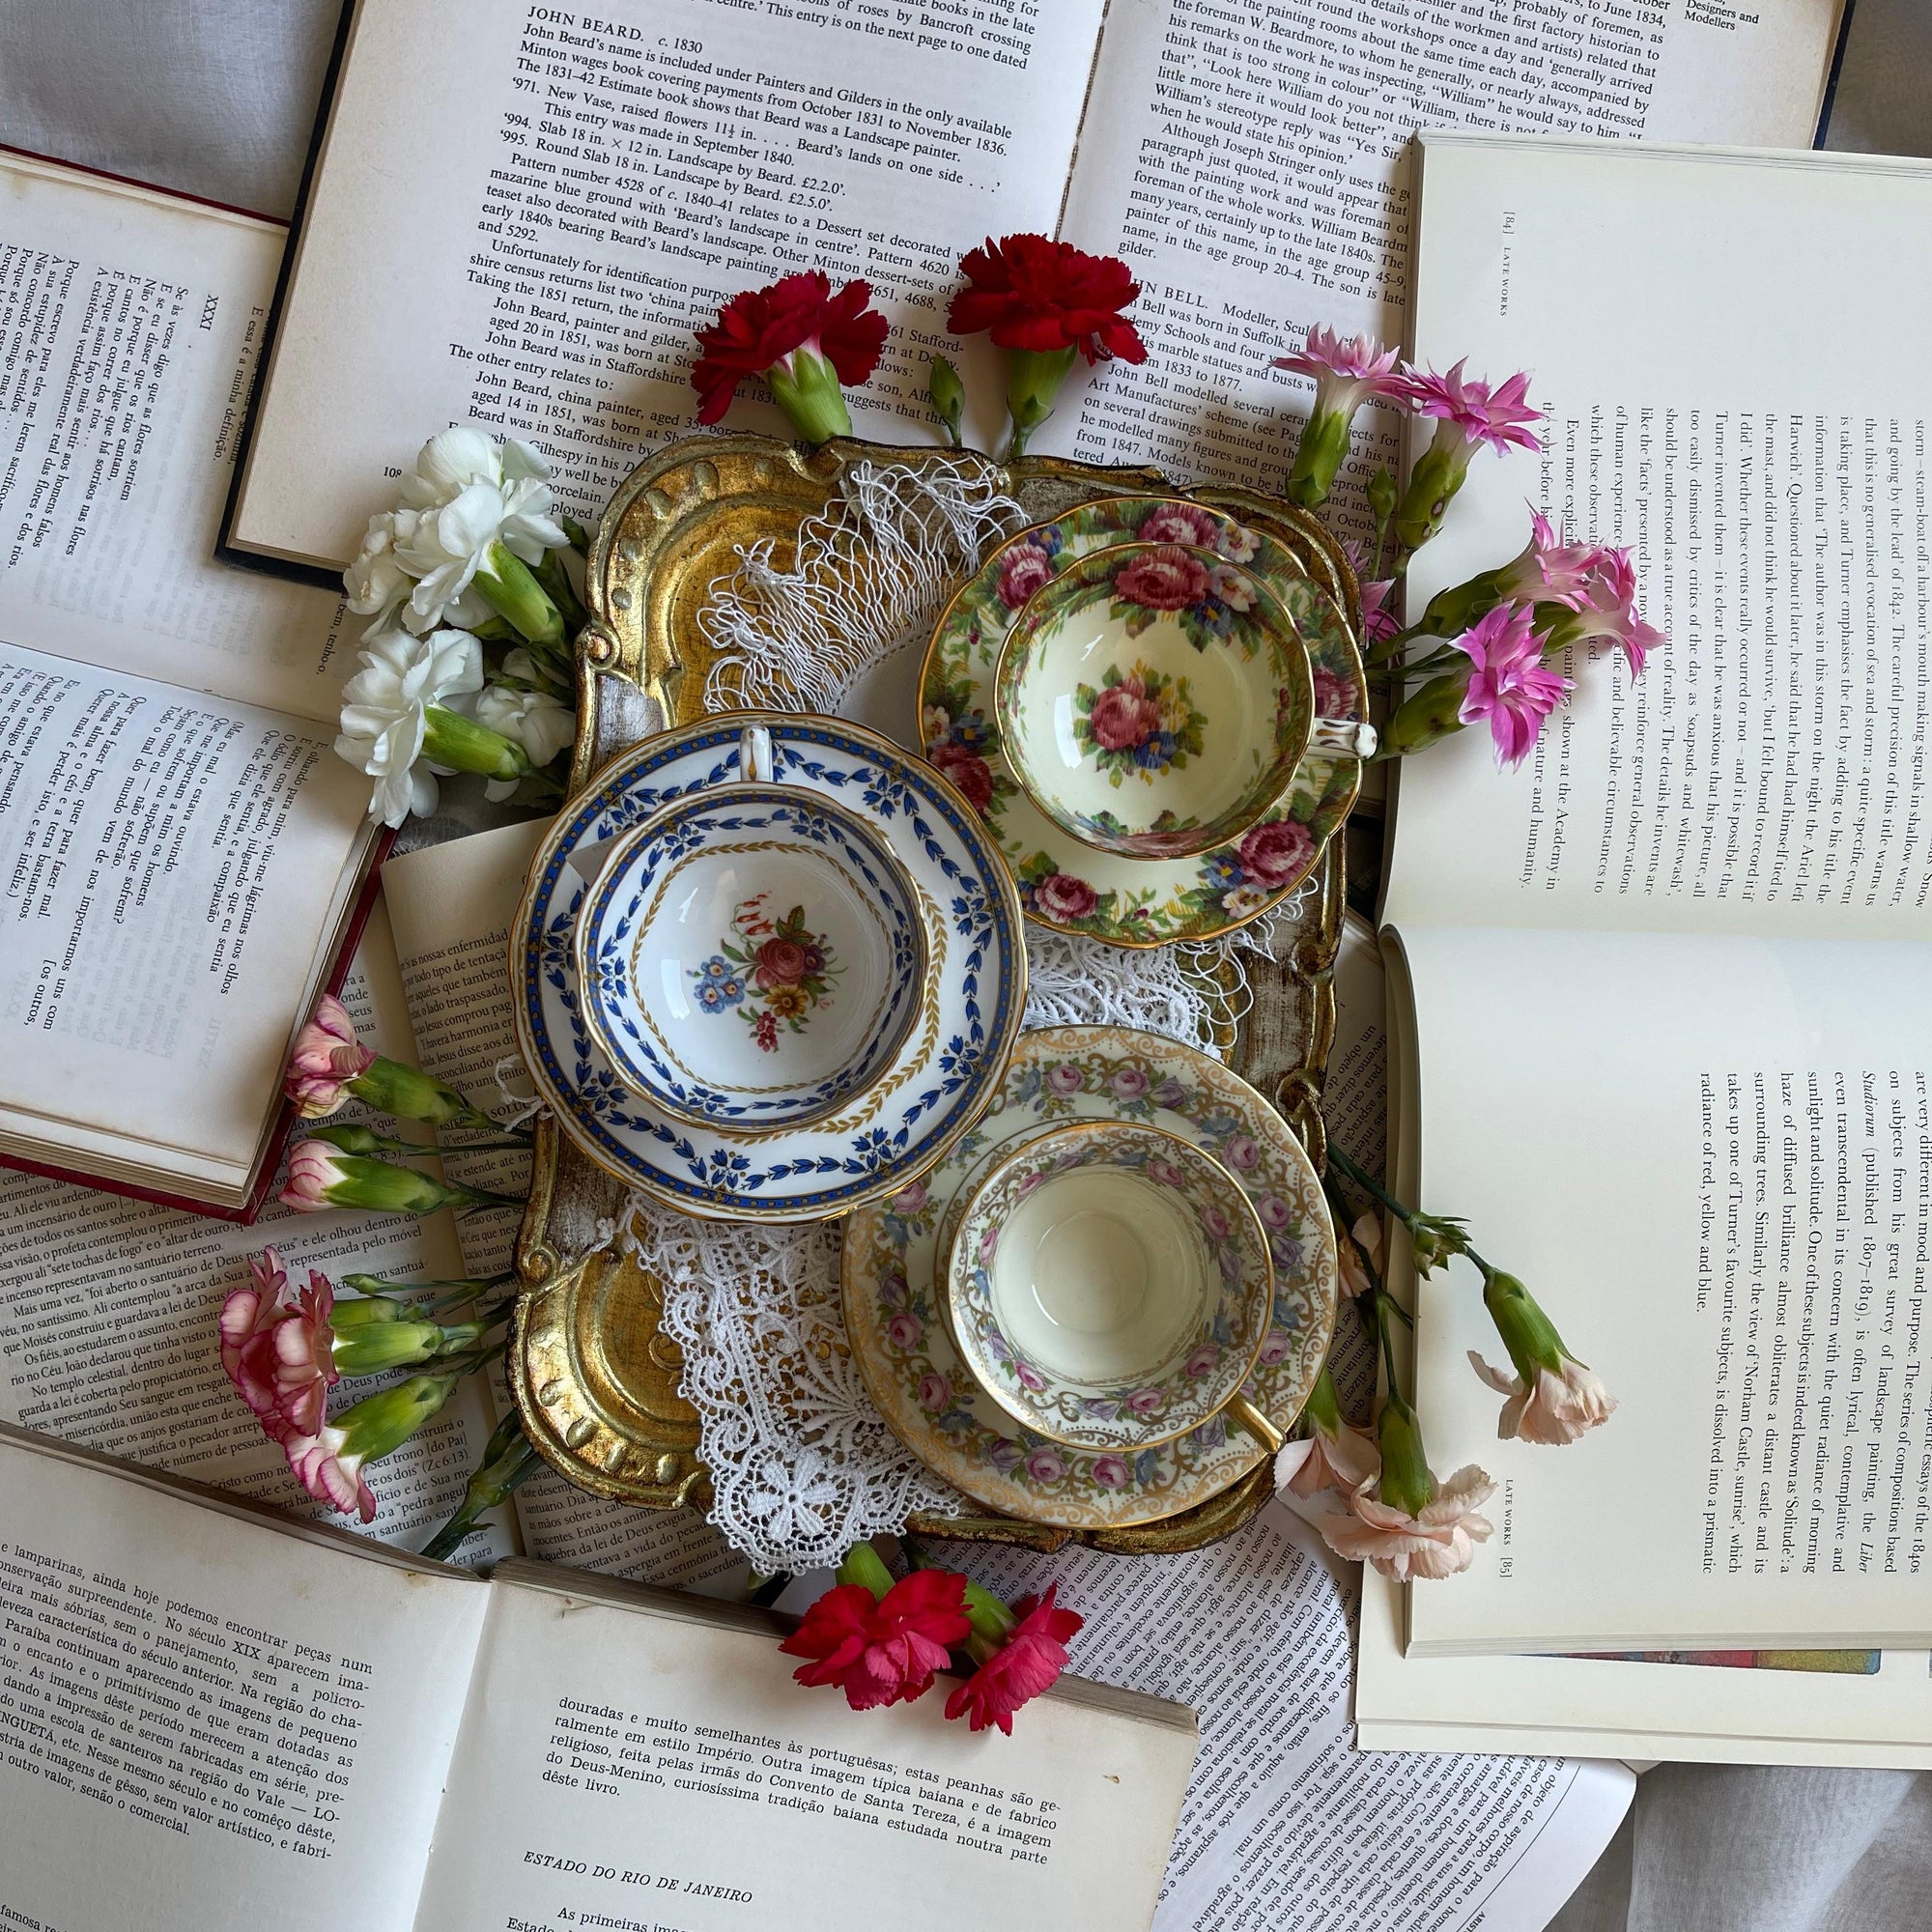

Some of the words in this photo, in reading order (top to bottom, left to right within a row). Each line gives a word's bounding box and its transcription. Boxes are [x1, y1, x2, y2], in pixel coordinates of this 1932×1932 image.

[1685, 10, 1736, 30] Modellers
[1687, 0, 1737, 18] Designers
[1739, 13, 1759, 24] and
[526, 5, 577, 27] JOHN
[581, 16, 644, 43] BEARD.
[658, 37, 668, 47] c.
[673, 37, 703, 54] 1830
[1173, 0, 1193, 11] the
[1194, 1, 1246, 26] foreman
[1250, 14, 1265, 31] W.
[1268, 20, 1338, 54] Beardmore,
[1342, 43, 1355, 56] to
[1358, 49, 1396, 69] whom
[1399, 58, 1414, 73] he
[1416, 66, 1475, 91] generally,
[1479, 81, 1494, 93] or
[1496, 85, 1536, 105] nearly
[1538, 94, 1582, 116] always,
[1585, 106, 1646, 129] addressed
[523, 22, 554, 41] John
[607, 43, 642, 60] name
[644, 48, 656, 63] is
[658, 51, 713, 74] included
[716, 67, 753, 83] under
[754, 71, 806, 94] Painters
[809, 86, 834, 99] and
[837, 89, 883, 108] Gilders
[885, 98, 898, 112] in
[902, 101, 923, 117] the
[924, 109, 954, 127] only
[956, 116, 1012, 139] available
[1150, 101, 1182, 120] when
[1185, 108, 1202, 124] he
[1205, 117, 1243, 135] would
[1244, 128, 1274, 144] state
[1276, 134, 1295, 151] his
[477, 220, 503, 235] and
[505, 224, 539, 242] 5292.
[1502, 211, 1516, 235] [84]
[1117, 241, 1156, 259] gilder.
[1502, 246, 1512, 275] LATE
[175, 286, 189, 300] Se
[1499, 278, 1510, 317] WORKS
[170, 304, 185, 317] às
[199, 294, 219, 332] XXXI
[251, 305, 265, 317] E
[161, 321, 177, 350] vezes
[243, 320, 257, 343] essa
[241, 346, 253, 355] é
[153, 354, 171, 379] digo
[448, 343, 474, 360] The
[476, 352, 512, 368] other
[513, 361, 548, 380] entry
[550, 368, 592, 386] relates
[595, 377, 614, 391] to:
[147, 382, 159, 404] que
[228, 368, 245, 404] minha
[142, 407, 153, 419] as
[1690, 410, 1701, 431] too
[132, 422, 153, 455] flores
[213, 408, 238, 462] definição.
[1686, 437, 1703, 473] easily
[120, 458, 138, 501] sorriem
[1689, 478, 1703, 540] dismissed
[1685, 547, 1703, 563] by
[1689, 569, 1702, 609] critics
[1689, 613, 1702, 630] of
[1689, 634, 1702, 655] the
[1685, 660, 1702, 687] day
[1688, 692, 1697, 706] as
[260, 729, 281, 746] Que
[251, 748, 267, 761] ele
[238, 763, 259, 786] dizia
[227, 789, 242, 810] que
[1681, 783, 1695, 810] and
[211, 813, 232, 849] sentia.
[40, 959, 57, 980] [os
[23, 983, 45, 1026] outros,
[341, 988, 368, 1003] onde
[349, 1007, 372, 1018] seus
[354, 1023, 376, 1034] mas
[1700, 1072, 1716, 1138] radiance
[1861, 1071, 1878, 1138] Studiorum
[1702, 1142, 1718, 1159] of
[1699, 1160, 1717, 1189] red,
[1861, 1147, 1880, 1225] (published
[1697, 1194, 1716, 1241] yellow
[1698, 1245, 1713, 1273] and
[13, 1303, 39, 1319] Mais
[39, 1298, 63, 1312] uma
[63, 1293, 84, 1305] vez,
[104, 1279, 138, 1295] aberto
[139, 1277, 148, 1288] o
[149, 1264, 198, 1285] santuário
[200, 1259, 213, 1272] de
[213, 1254, 244, 1268] Deus
[1696, 1278, 1713, 1313] blue.
[1855, 1329, 1865, 1341] is
[1851, 1348, 1867, 1382] often
[1842, 1390, 1864, 1437] lyrical,
[1504, 1479, 1514, 1506] LATE
[1834, 1445, 1854, 1540] contemplative
[1503, 1508, 1513, 1546] WORKS
[1498, 1556, 1514, 1578] [85]
[1832, 1547, 1846, 1573] and
[0, 1543, 9, 1553] e
[14, 1545, 86, 1581] lamparinas,
[92, 1572, 127, 1593] ainda
[132, 1584, 159, 1605] hoje
[164, 1599, 219, 1626] podemos
[225, 1620, 289, 1650] encontrar
[293, 1643, 332, 1663] peças
[340, 1657, 373, 1675] num
[1334, 1735, 1343, 1744] o
[1291, 1743, 1336, 1792] sofrimento
[8, 1754, 40, 1775] outro
[43, 1768, 75, 1792] valor,
[79, 1784, 114, 1805] senão
[117, 1799, 126, 1809] o
[128, 1804, 190, 1836] comercial.
[542, 1769, 579, 1788] dêste
[584, 1777, 620, 1797] livro.
[1233, 1790, 1251, 1809] que
[1267, 1791, 1292, 1817] como
[1217, 1809, 1236, 1829] nós
[1251, 1817, 1269, 1835] um
[1175, 1829, 1219, 1877] aspiramos,
[1232, 1835, 1254, 1859] mal.
[523, 1850, 587, 1874] ESTADO
[591, 1864, 616, 1880] DO
[619, 1870, 651, 1886] RIO
[655, 1876, 680, 1890] DE
[683, 1881, 753, 1903] JANEIRO
[0, 1904, 41, 1931] famosa
[556, 1906, 576, 1921] As
[579, 1913, 648, 1932] primeiras
